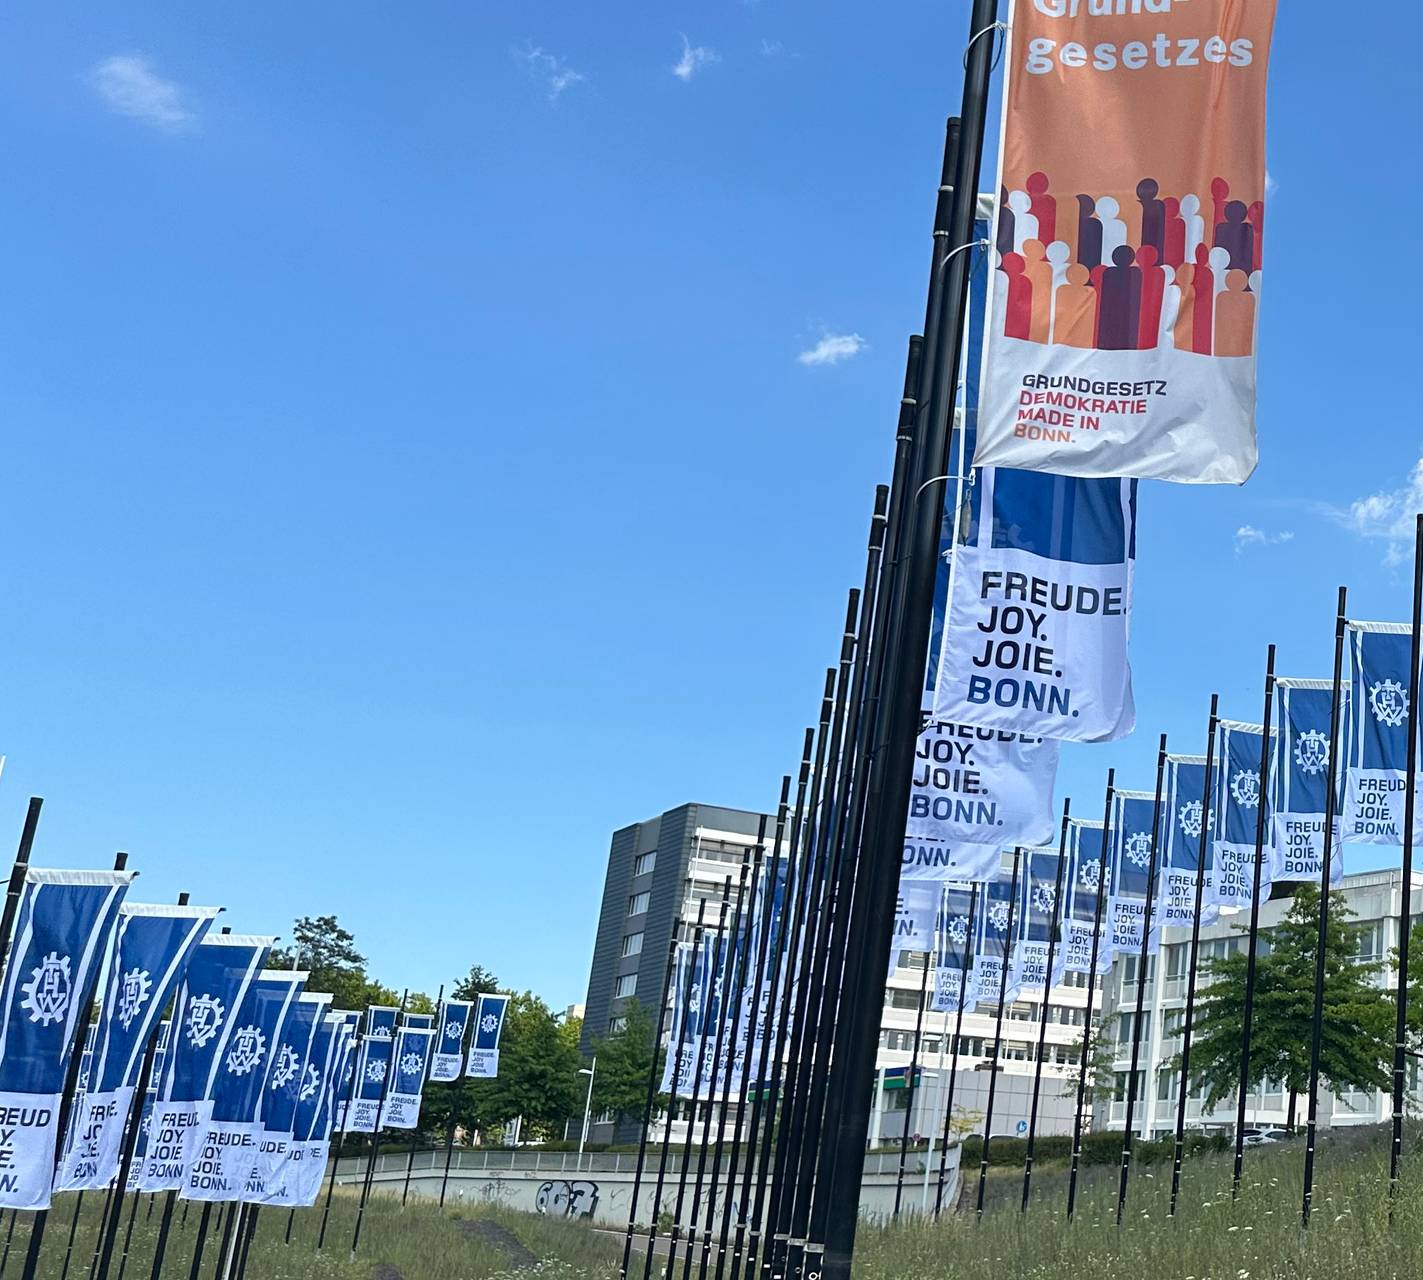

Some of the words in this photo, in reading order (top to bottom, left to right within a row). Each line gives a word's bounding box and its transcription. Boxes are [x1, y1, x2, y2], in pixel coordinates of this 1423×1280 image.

[1025, 33, 1253, 75] gesetzes
[1022, 374, 1167, 396] GRUNDGESETZ
[1019, 390, 1147, 415] DEMOKRATIE
[1018, 407, 1075, 428] MADE
[1080, 415, 1100, 431] IN
[1014, 422, 1076, 443] BONN.
[981, 571, 1127, 616] FREUDE.
[977, 606, 1048, 641] JOY.
[972, 640, 1062, 678] JOIE.
[967, 675, 1079, 718] BONN.
[917, 739, 975, 766] JOY.
[913, 765, 988, 795] JOIE.
[1359, 778, 1418, 794] FREUD.
[1357, 793, 1388, 806] JOY.
[910, 794, 1003, 826] BONN.
[1356, 806, 1392, 820] JOIE.
[1355, 821, 1399, 835] BONN.
[1286, 834, 1312, 846] JOY.
[902, 845, 956, 867] ONN.
[1285, 847, 1319, 859] JOIE.
[1221, 862, 1243, 875] JOY.
[1221, 873, 1248, 887] JOIE.
[1168, 886, 1190, 896] JOY.
[1115, 903, 1157, 916] FREUE
[157, 1129, 183, 1143] JOY.
[150, 1146, 182, 1160] JOIE.
[191, 1176, 232, 1191] BONN.
